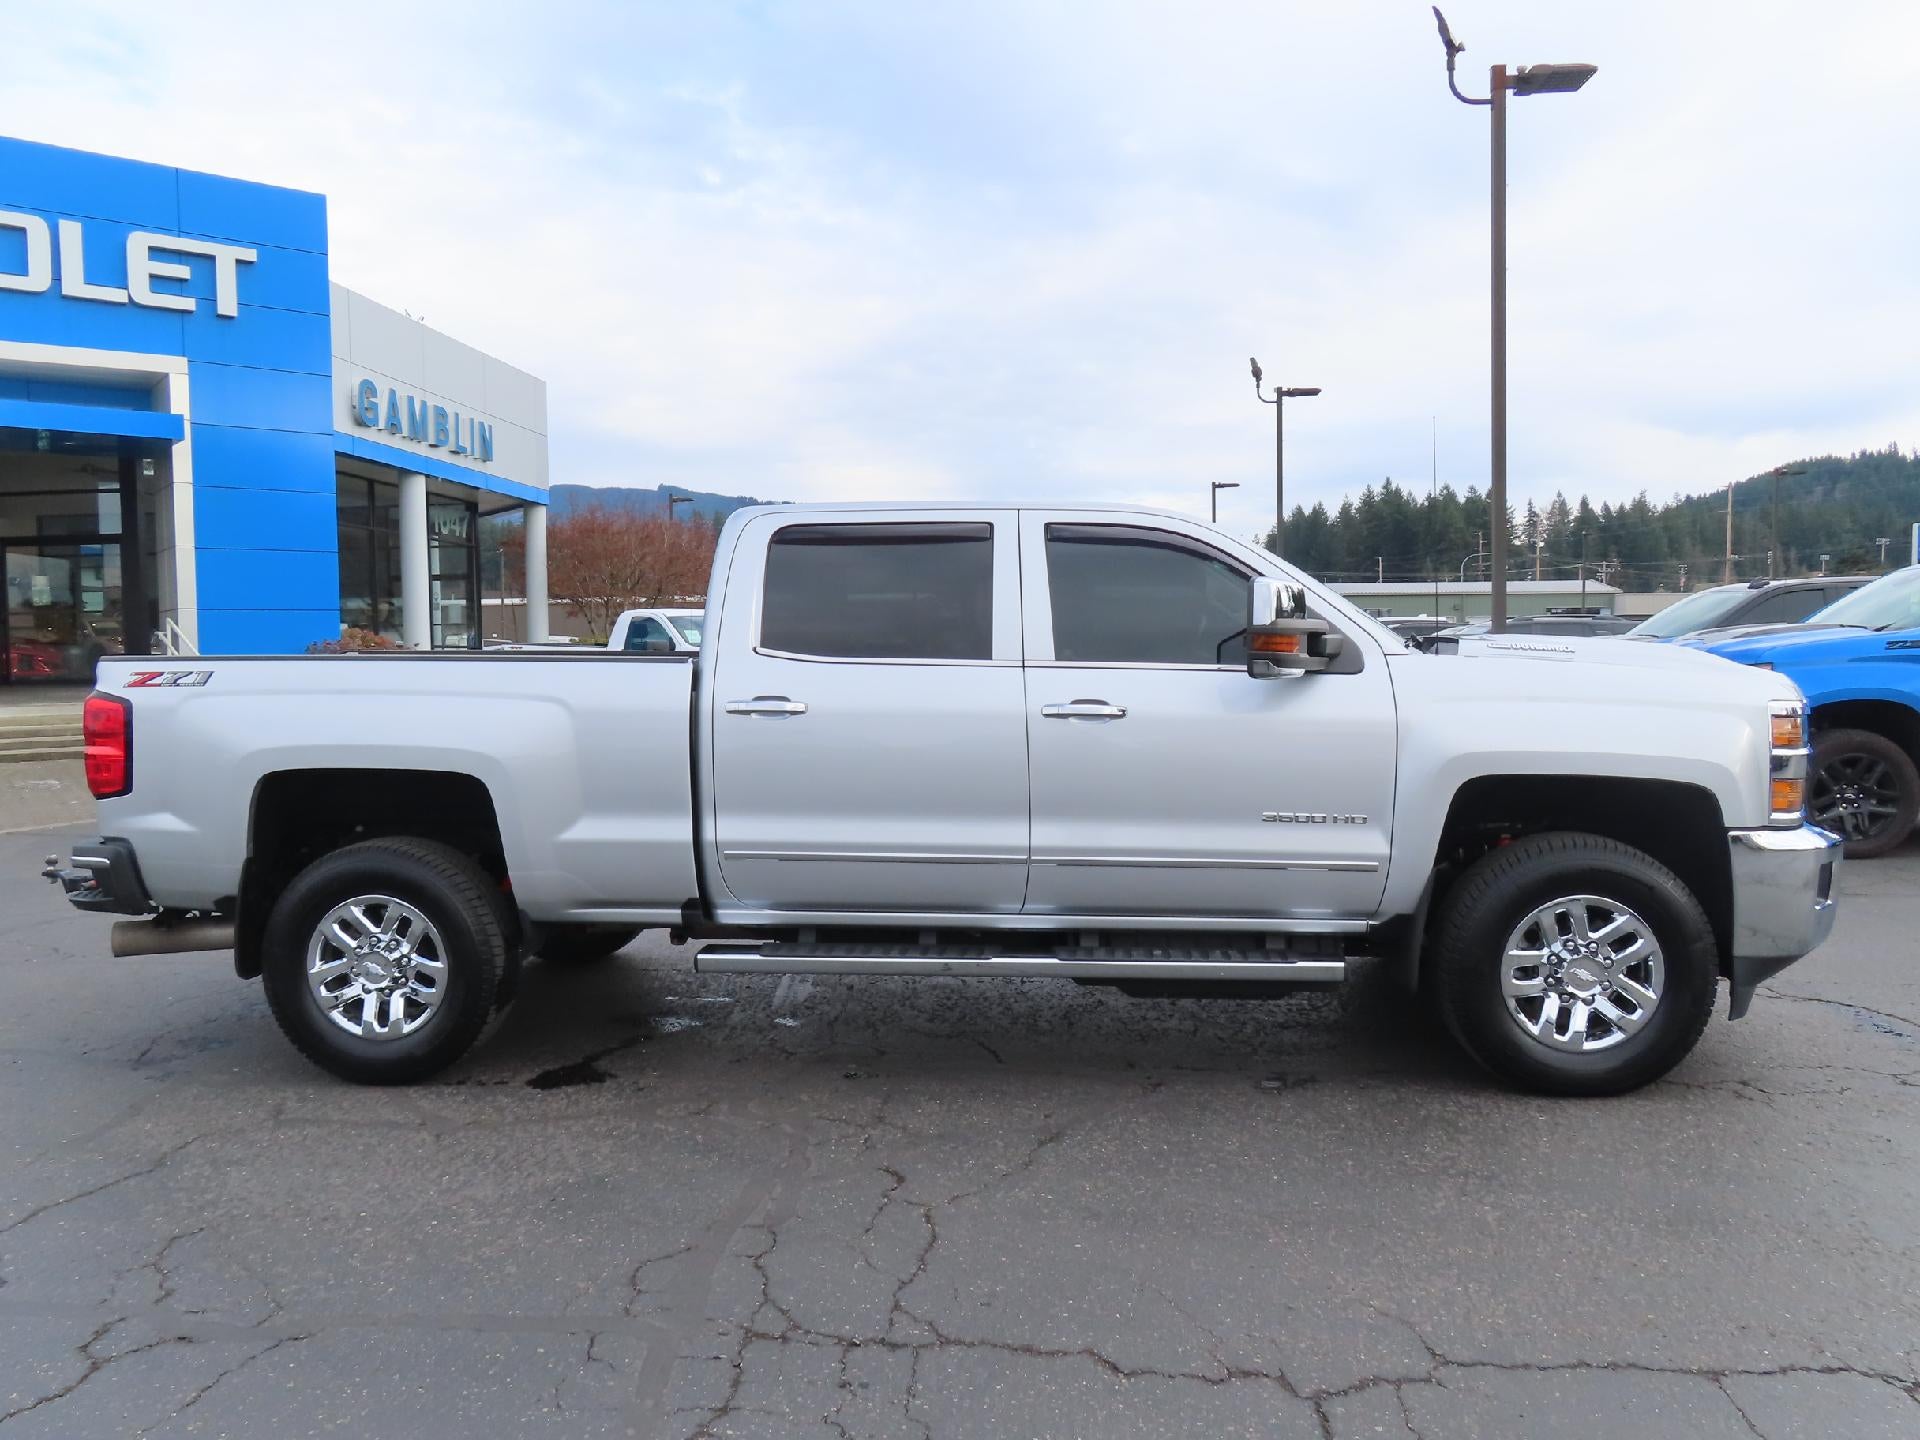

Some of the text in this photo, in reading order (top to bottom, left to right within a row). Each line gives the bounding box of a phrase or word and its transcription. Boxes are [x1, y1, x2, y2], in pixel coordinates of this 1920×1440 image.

[351, 378, 494, 463] GAMBLIN
[122, 671, 215, 688] Z71
[1261, 812, 1368, 824] 3500 HD
